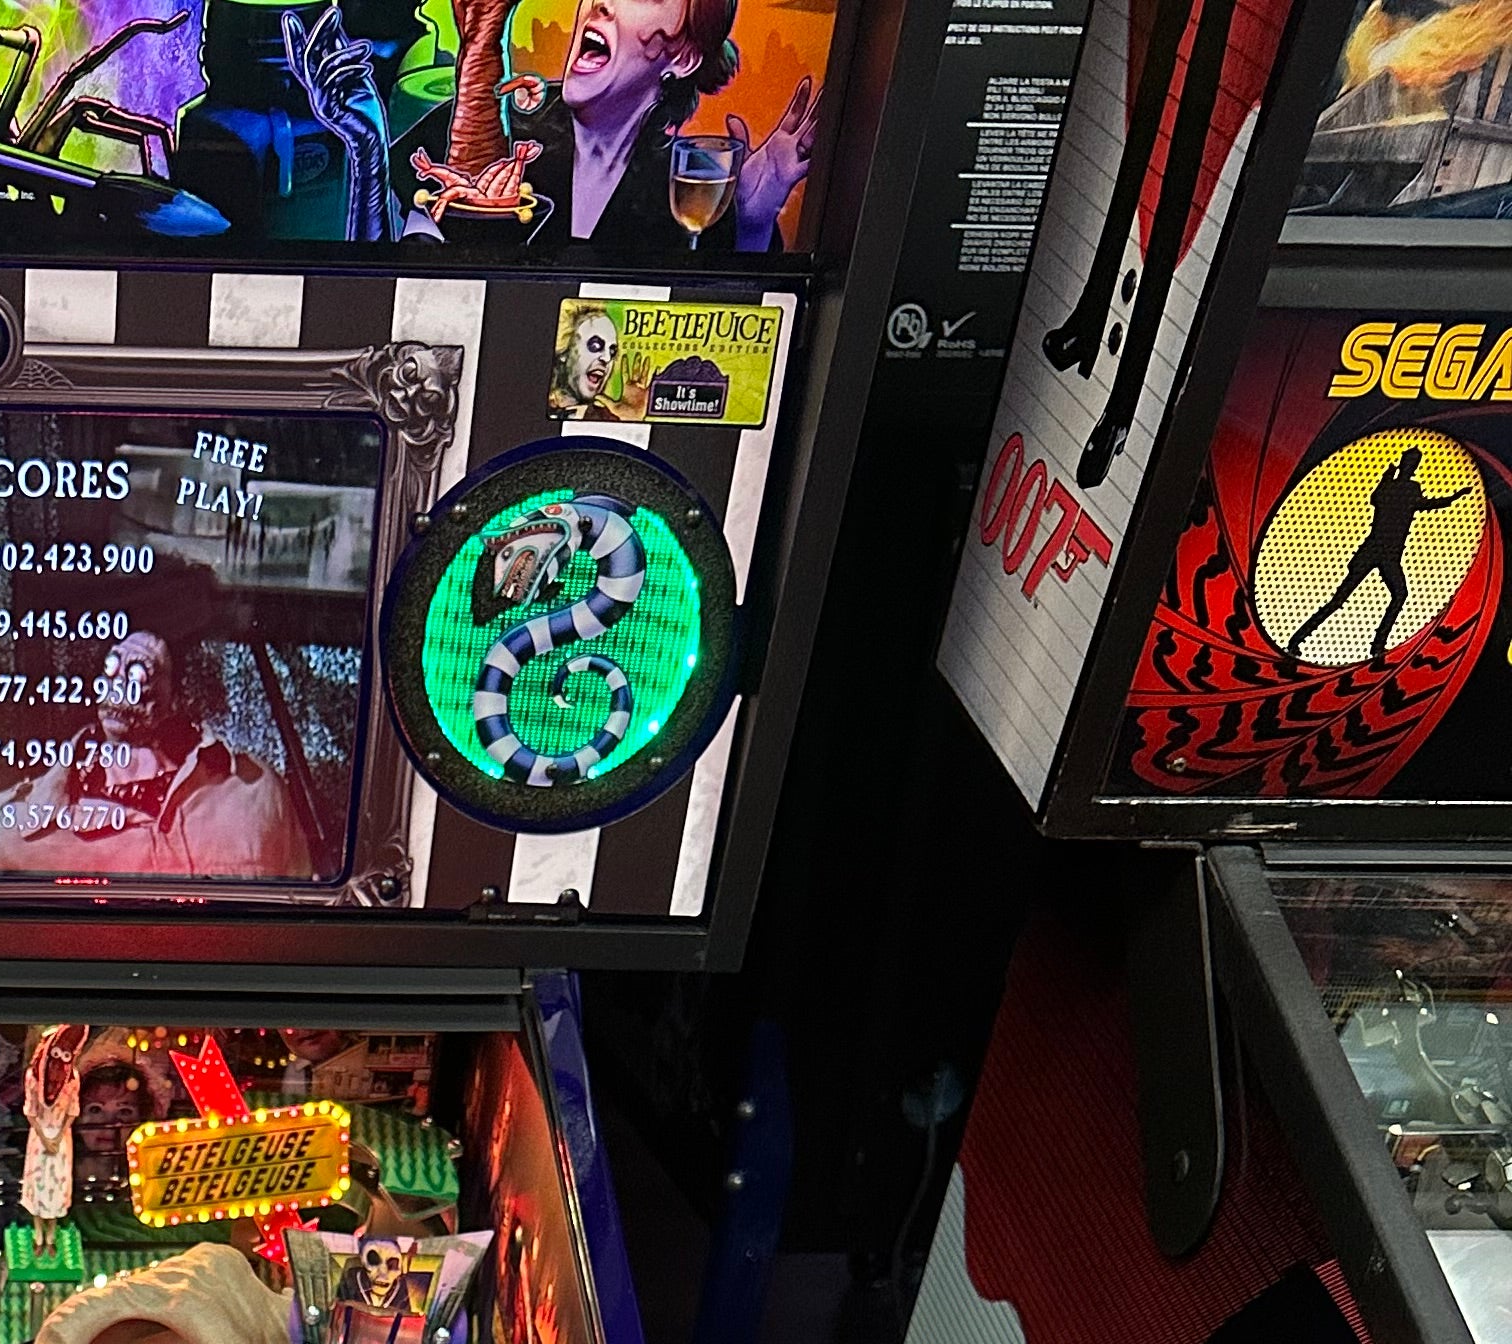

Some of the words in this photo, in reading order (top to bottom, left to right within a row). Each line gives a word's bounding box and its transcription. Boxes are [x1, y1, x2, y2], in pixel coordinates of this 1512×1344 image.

[622, 341, 698, 352] COLLECTORS
[710, 343, 769, 354] EDITION
[624, 309, 775, 347] BEETLEJUICE
[655, 397, 719, 412] Showtime!
[676, 385, 696, 399] It's
[193, 431, 269, 473] FREE
[177, 478, 264, 521] PLAY!
[979, 431, 1114, 600] 007
[158, 1129, 315, 1174] BETELGEUSE
[159, 1161, 315, 1206] BETELGEUSE
